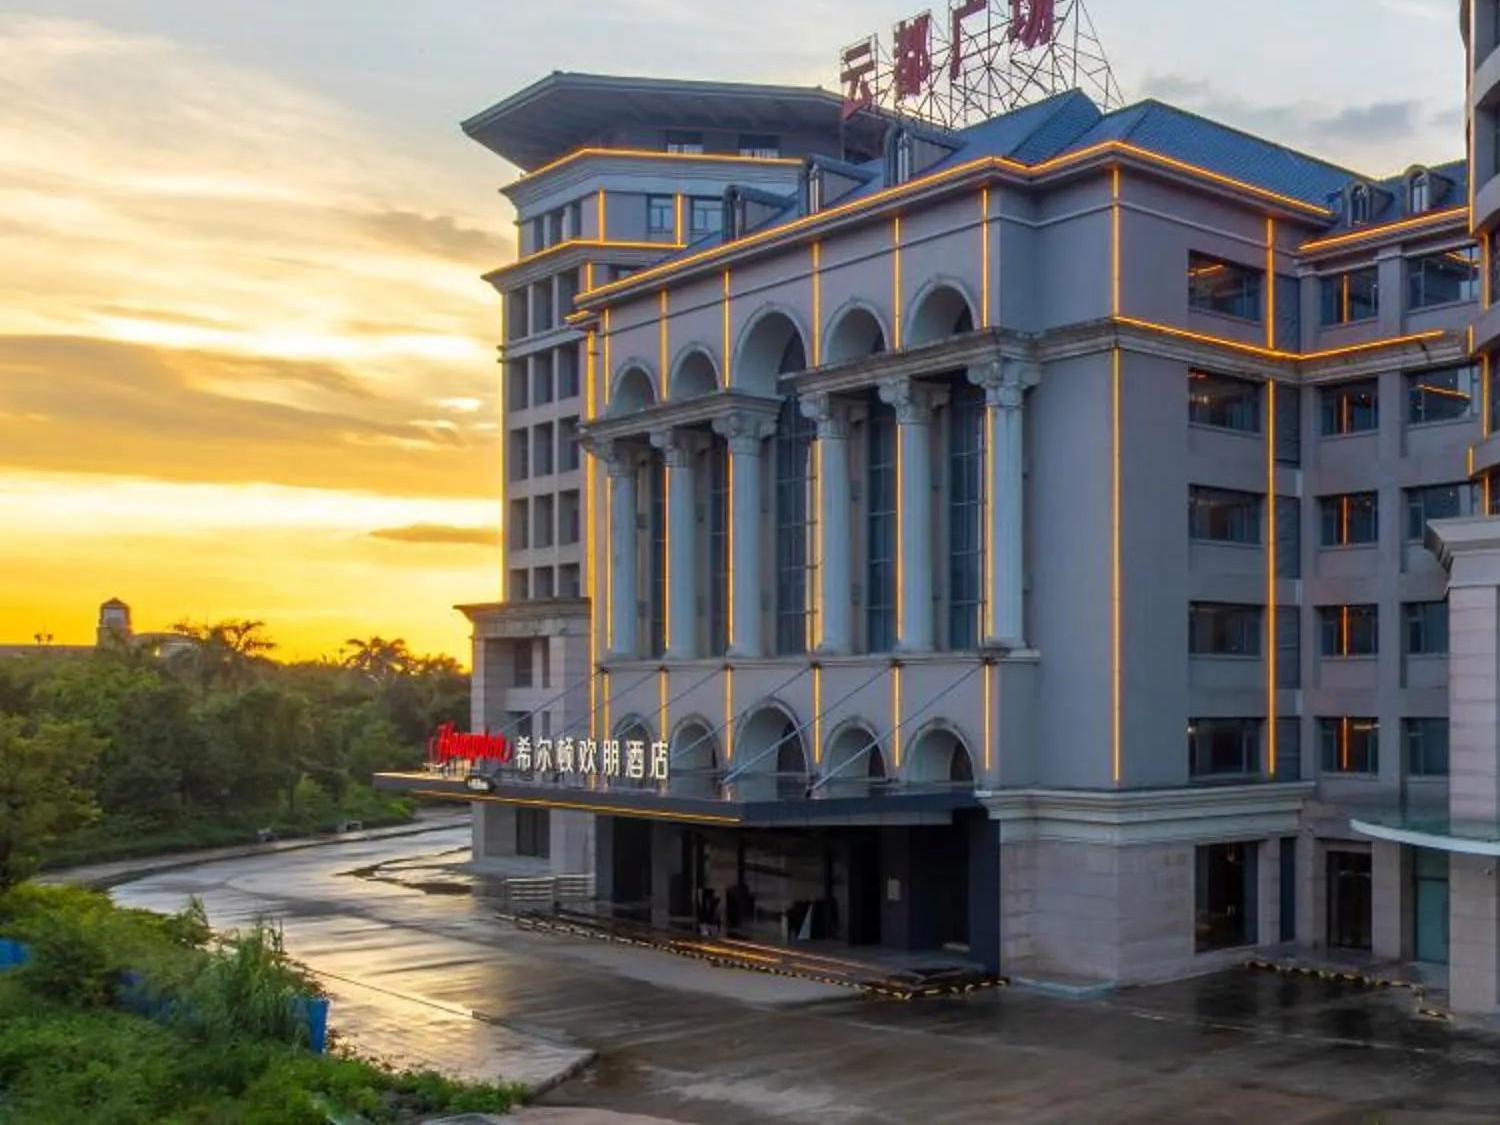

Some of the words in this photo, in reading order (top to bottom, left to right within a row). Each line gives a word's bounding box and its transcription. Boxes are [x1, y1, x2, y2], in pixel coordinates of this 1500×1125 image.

[516, 736, 669, 780] 希尔顿欢朋酒店
